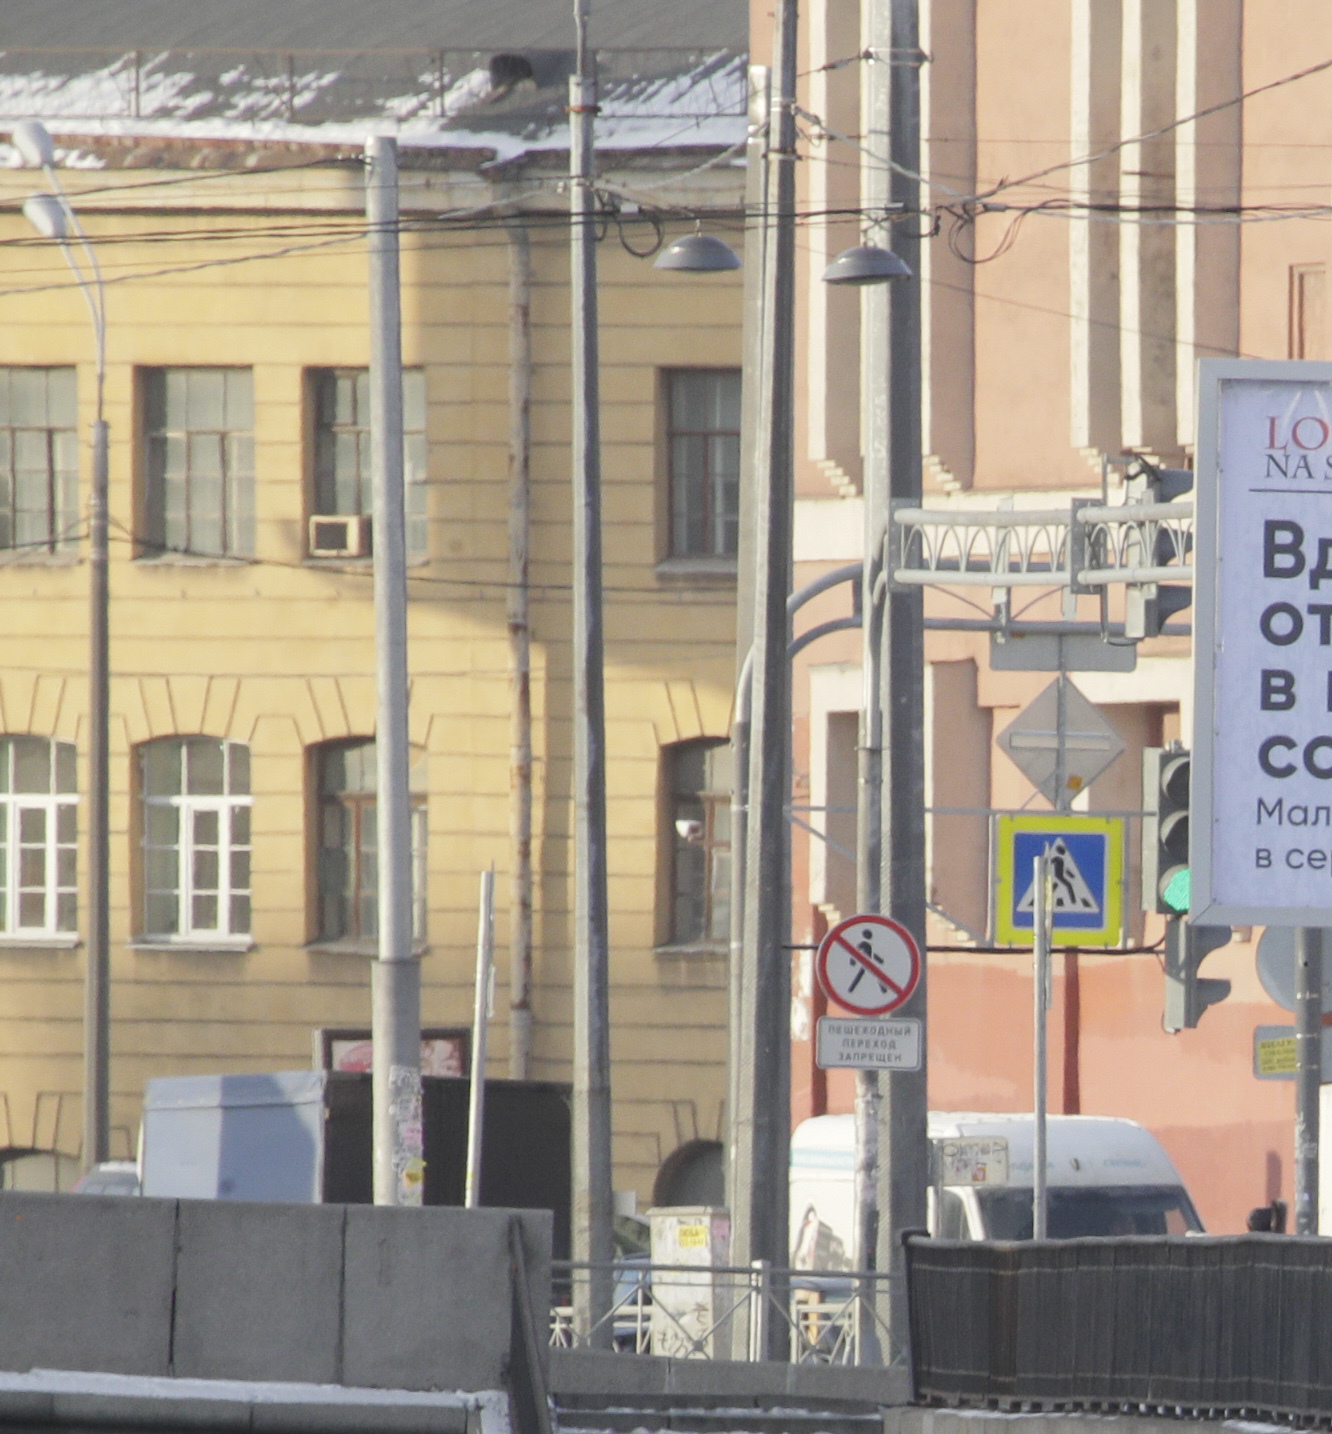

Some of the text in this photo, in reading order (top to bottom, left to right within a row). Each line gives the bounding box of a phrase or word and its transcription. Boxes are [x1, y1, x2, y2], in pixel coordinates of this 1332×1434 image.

[1264, 454, 1315, 480] NA
[1260, 669, 1296, 711] в
[1255, 847, 1273, 869] в
[841, 1038, 897, 1050] ПЕРЕХОД
